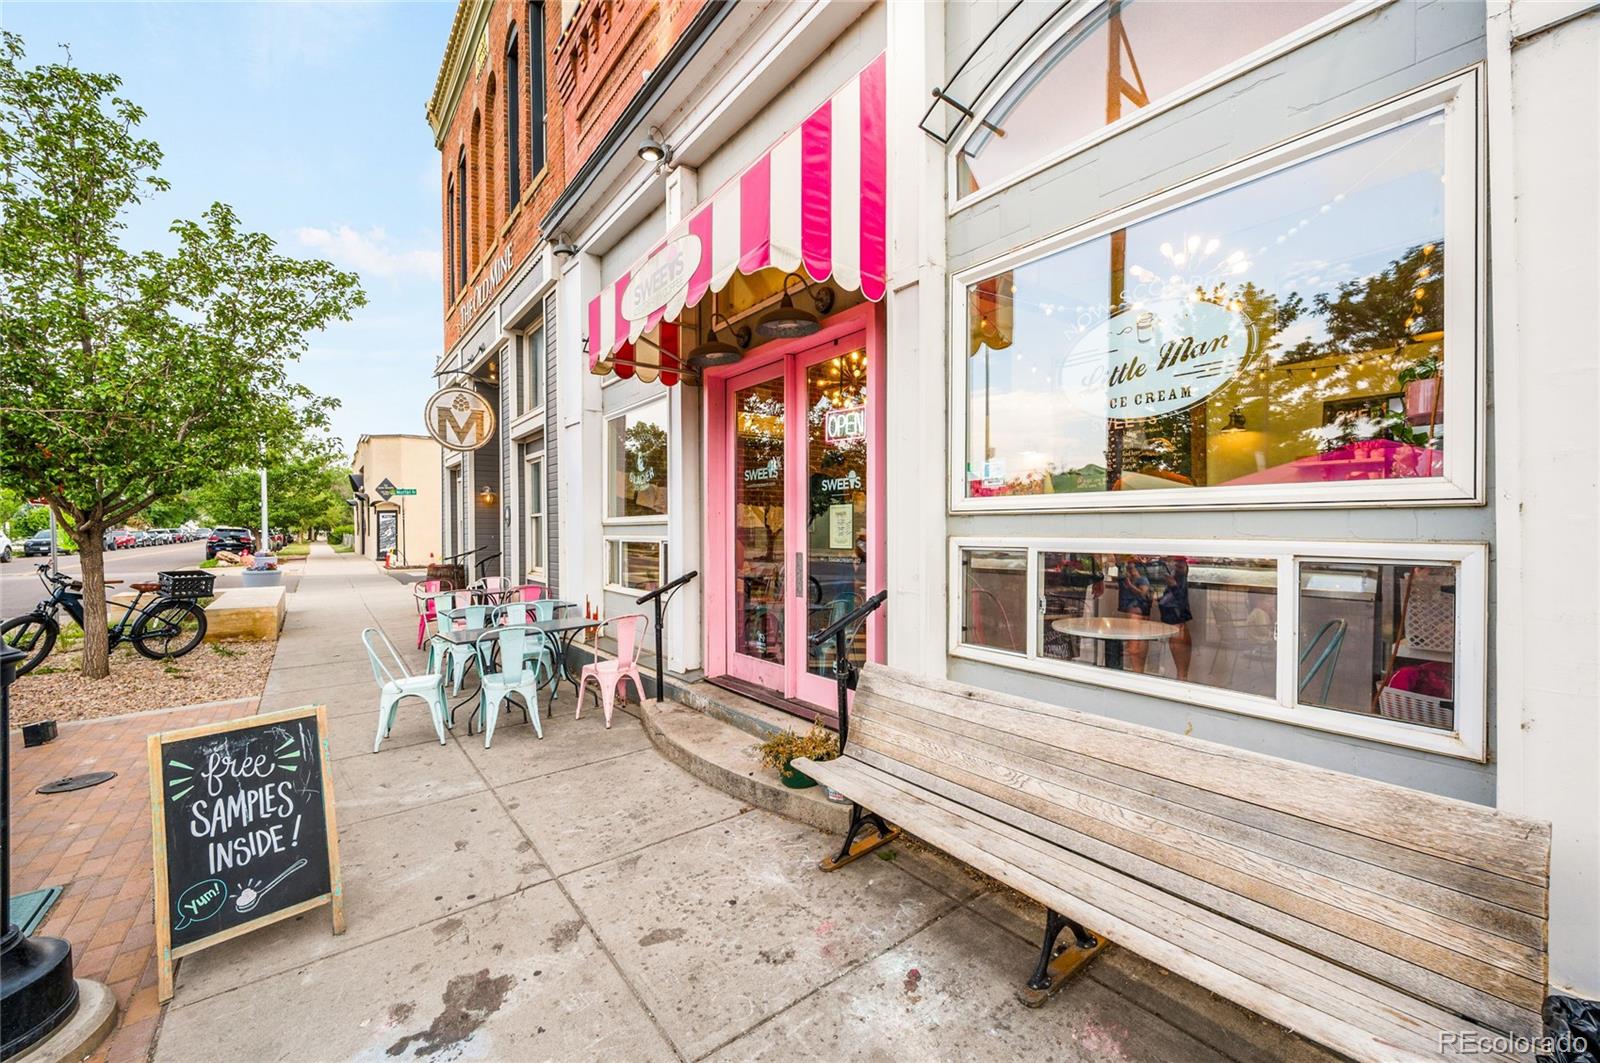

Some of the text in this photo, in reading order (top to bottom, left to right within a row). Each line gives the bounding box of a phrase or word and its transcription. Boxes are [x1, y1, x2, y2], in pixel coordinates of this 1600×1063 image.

[460, 242, 514, 329] THE OLD MINE
[1156, 333, 1230, 371] Man
[1134, 386, 1193, 405] CREAM
[828, 411, 864, 437] OPEN
[202, 752, 275, 796] free
[190, 781, 294, 838] SAMPLES
